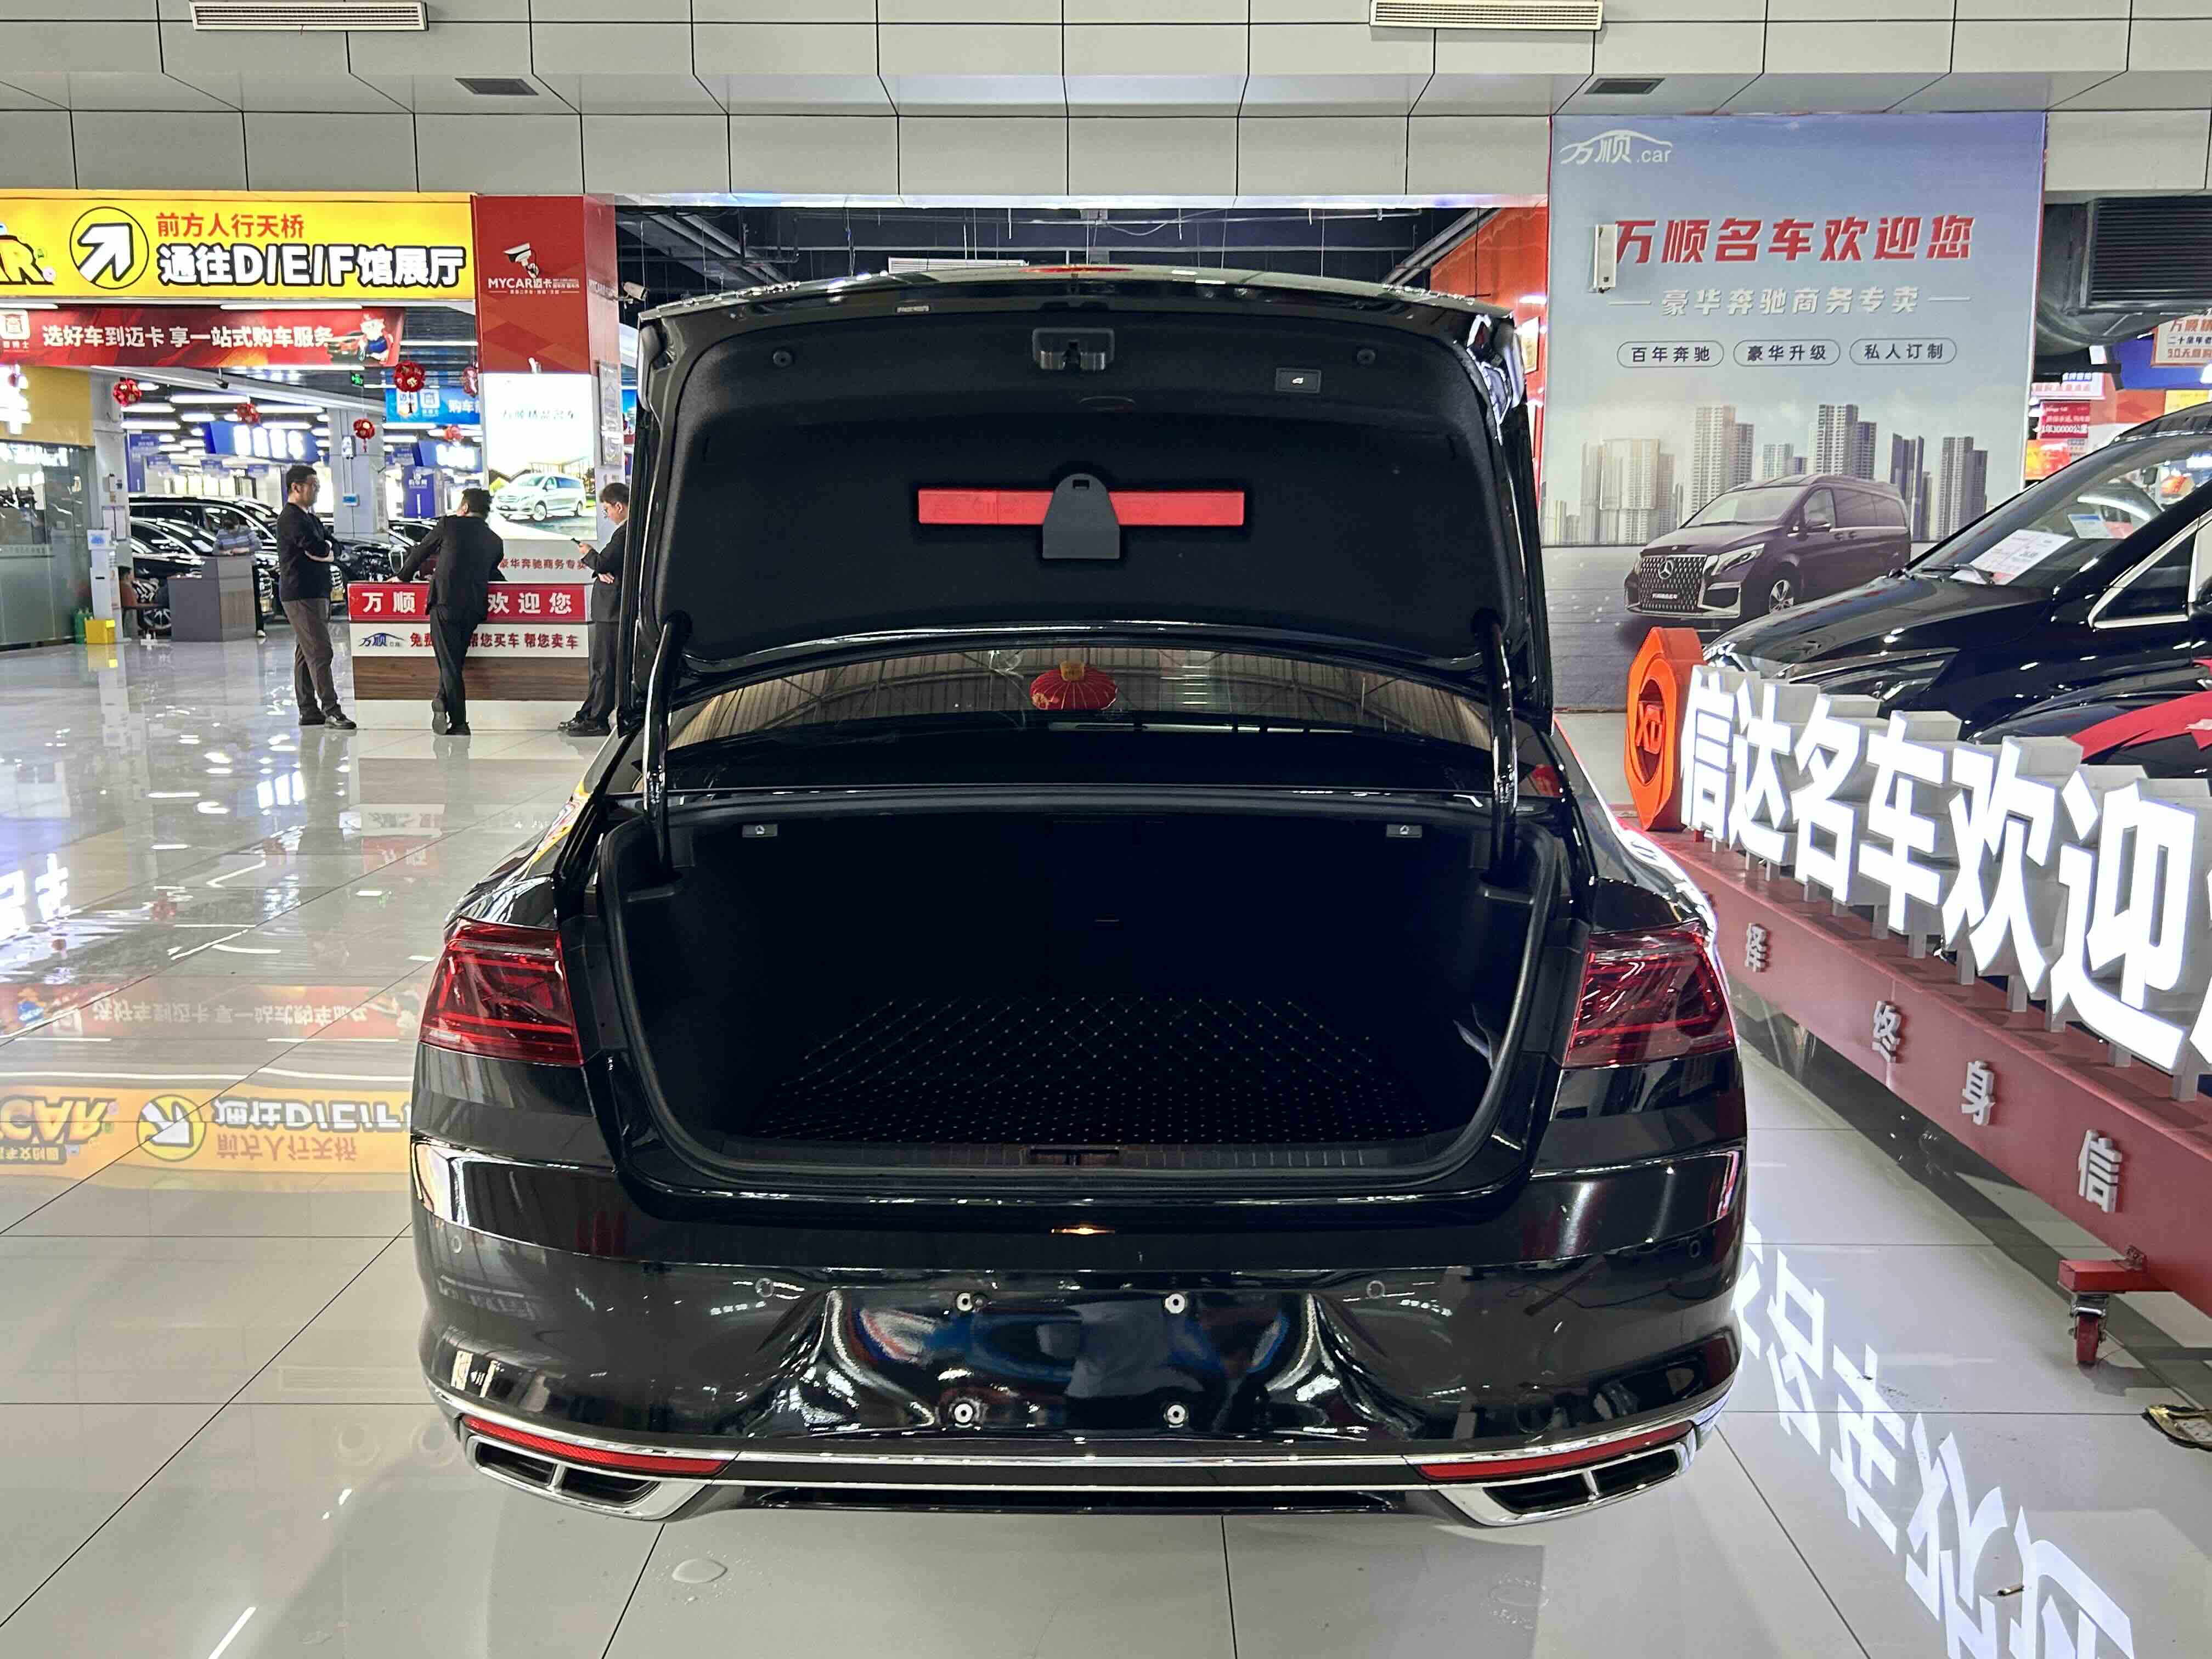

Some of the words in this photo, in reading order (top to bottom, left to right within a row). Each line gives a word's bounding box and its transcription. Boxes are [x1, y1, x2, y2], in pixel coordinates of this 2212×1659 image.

[156, 213, 304, 239] 前方人行天桥
[1614, 214, 1975, 264] 万顺名车欢迎您
[1661, 286, 1920, 317] 豪华奔驰商务专卖
[42, 325, 164, 348] 选好车到迈卡
[168, 324, 334, 348] 享一站式购车服务
[1631, 346, 1710, 363] 百年奔驰
[1747, 345, 1827, 362] 豪华升级
[1864, 343, 1944, 360] 私人订制
[1680, 664, 2212, 1071] 信达名车欢迎
